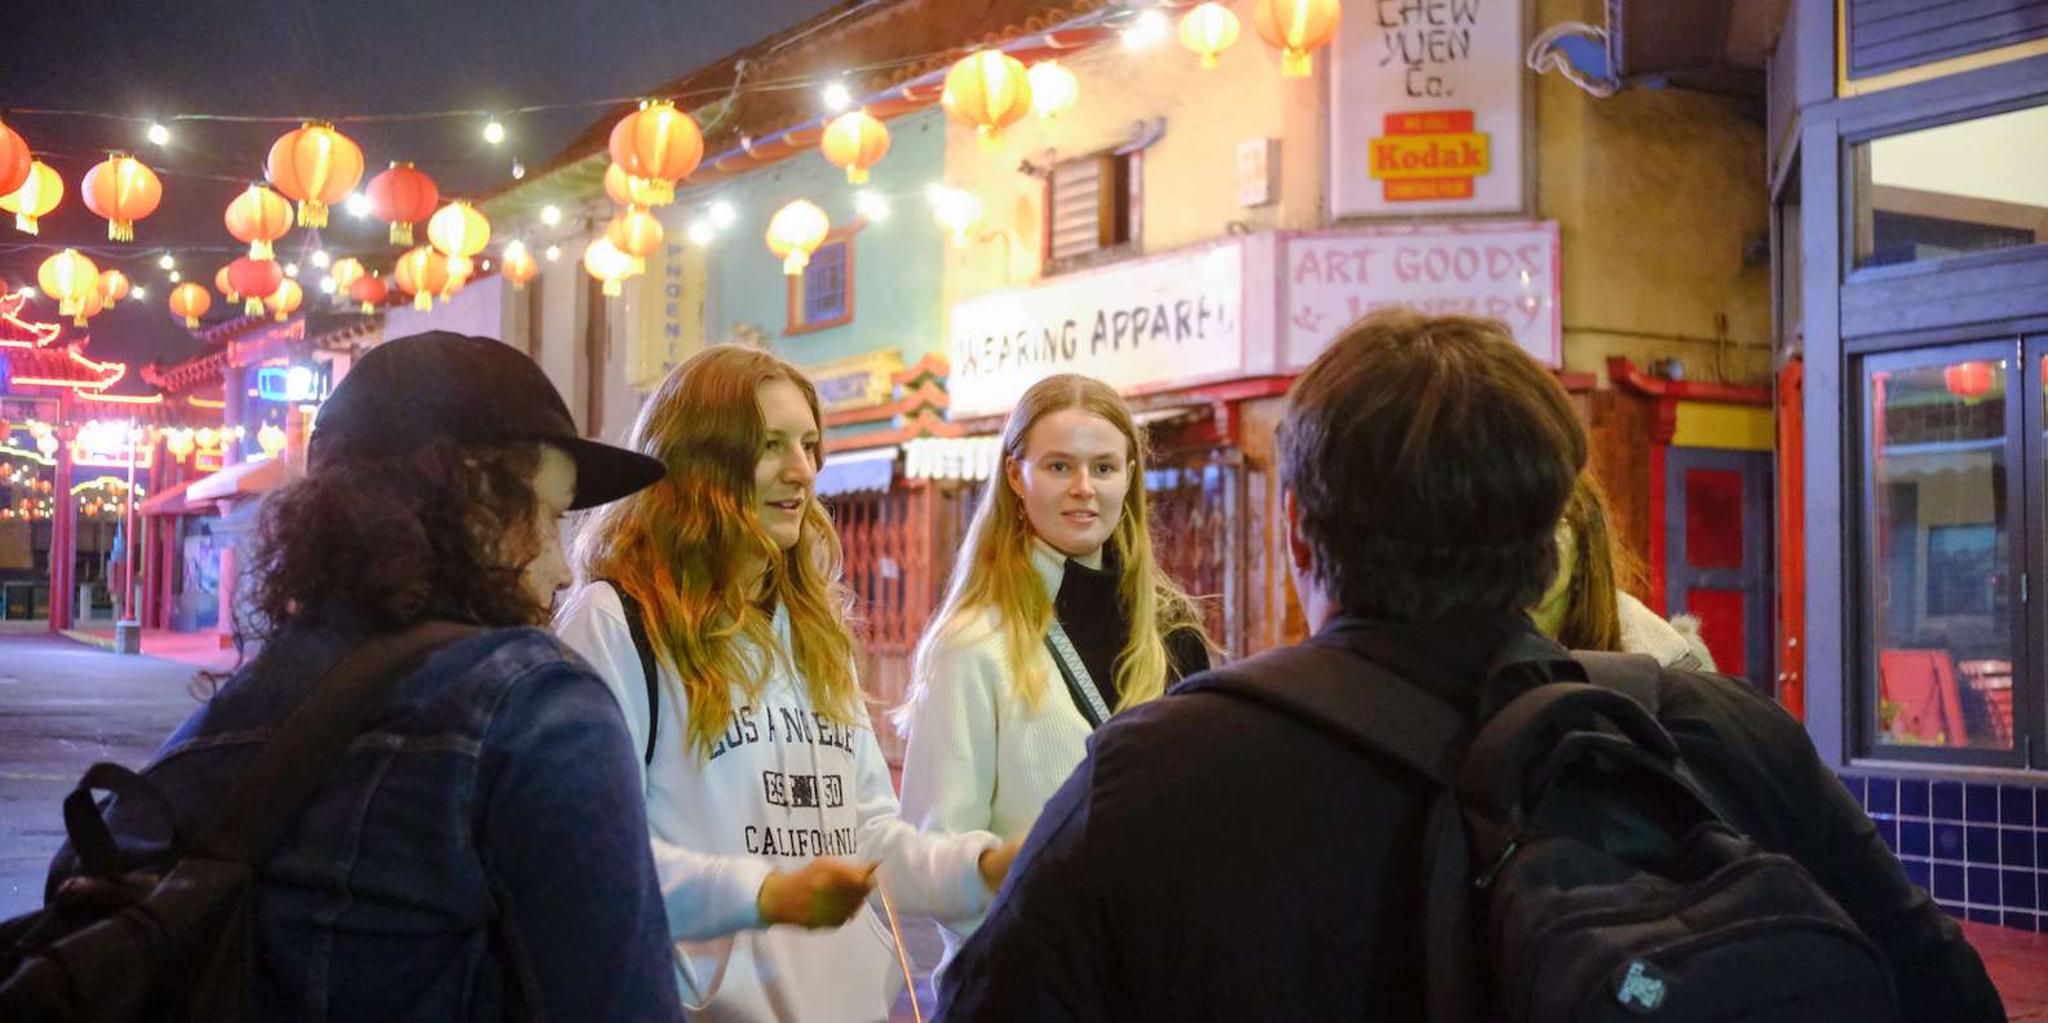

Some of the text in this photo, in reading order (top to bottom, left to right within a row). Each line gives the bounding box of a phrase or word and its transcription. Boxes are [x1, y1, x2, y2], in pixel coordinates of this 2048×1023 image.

[1376, 0, 1480, 27] CHEW
[1379, 28, 1471, 67] YUEN
[1375, 141, 1482, 170] Kodak
[1294, 244, 1543, 284] ART GOODS
[744, 825, 857, 858] CALIFORNI
